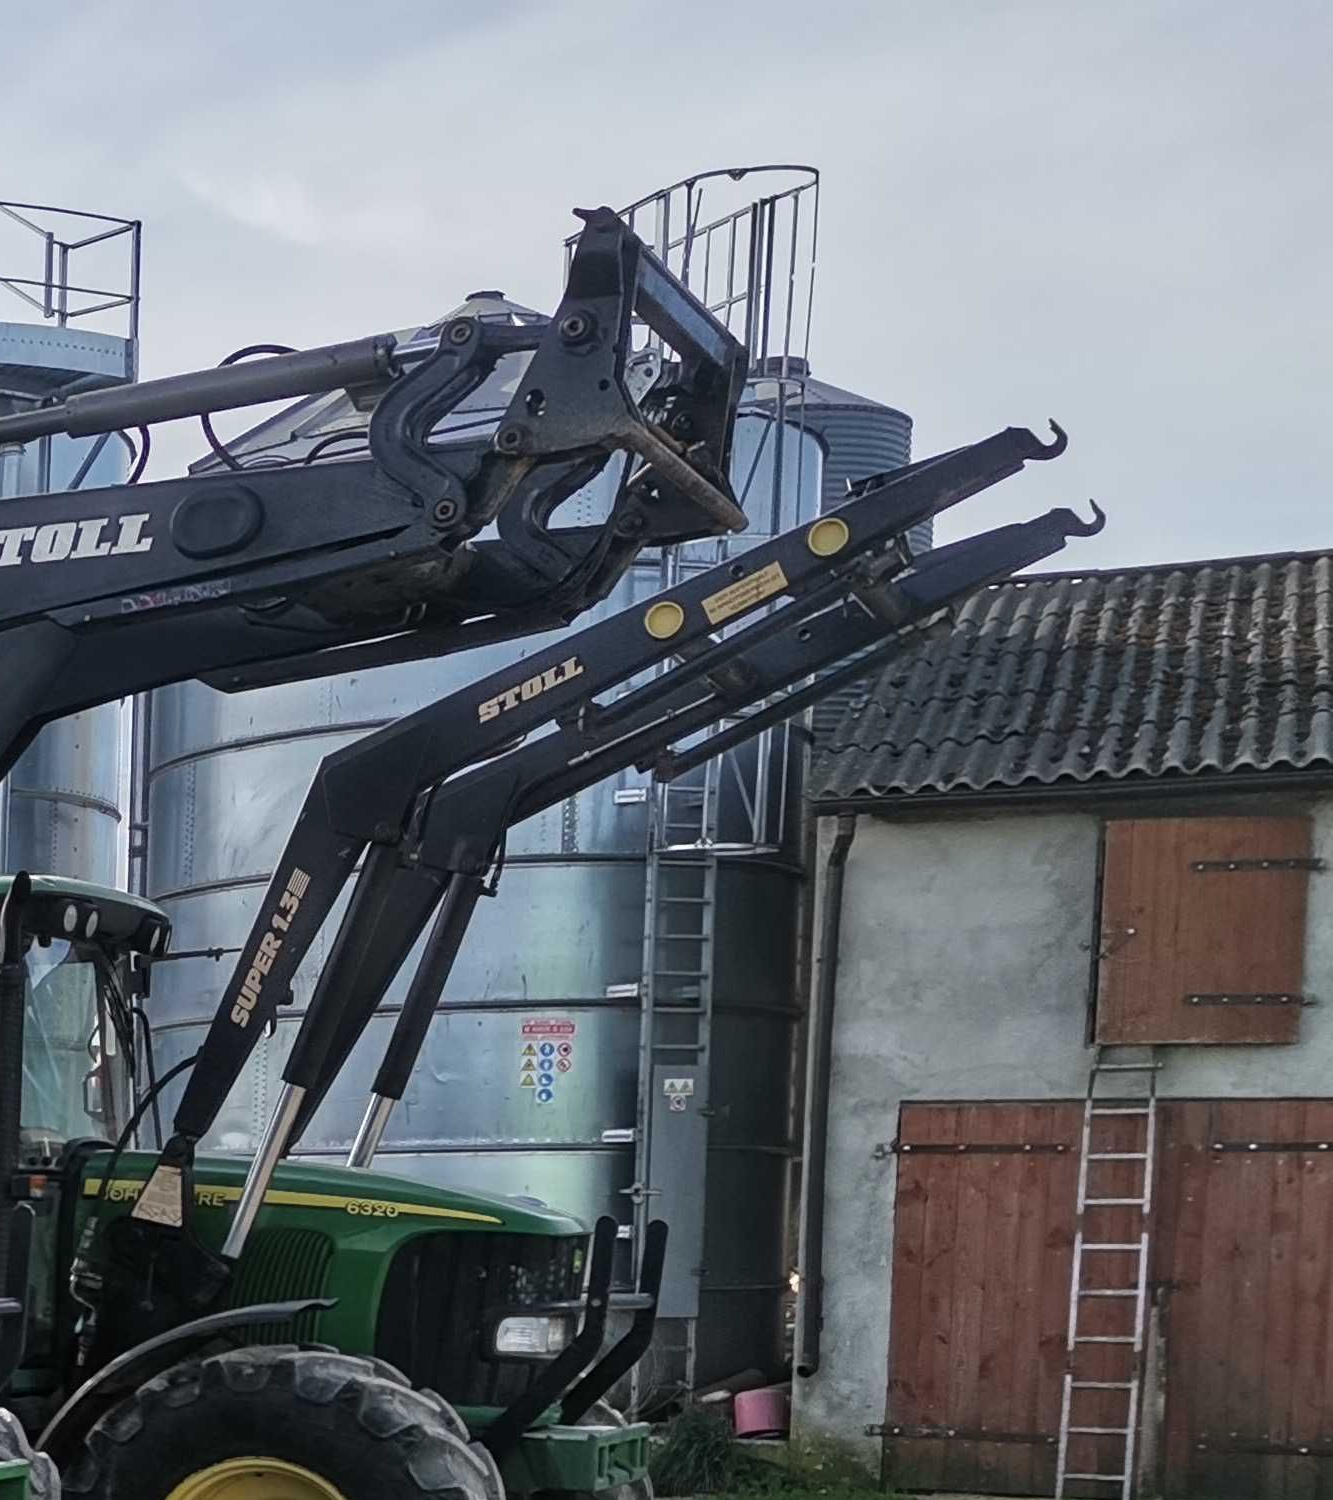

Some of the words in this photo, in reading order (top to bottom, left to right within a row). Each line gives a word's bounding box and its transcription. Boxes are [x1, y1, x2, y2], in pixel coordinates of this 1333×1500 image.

[478, 656, 584, 724] STOLL
[230, 931, 284, 1029] SUPER
[271, 890, 300, 932] 1.3
[347, 1200, 400, 1218] 6320
